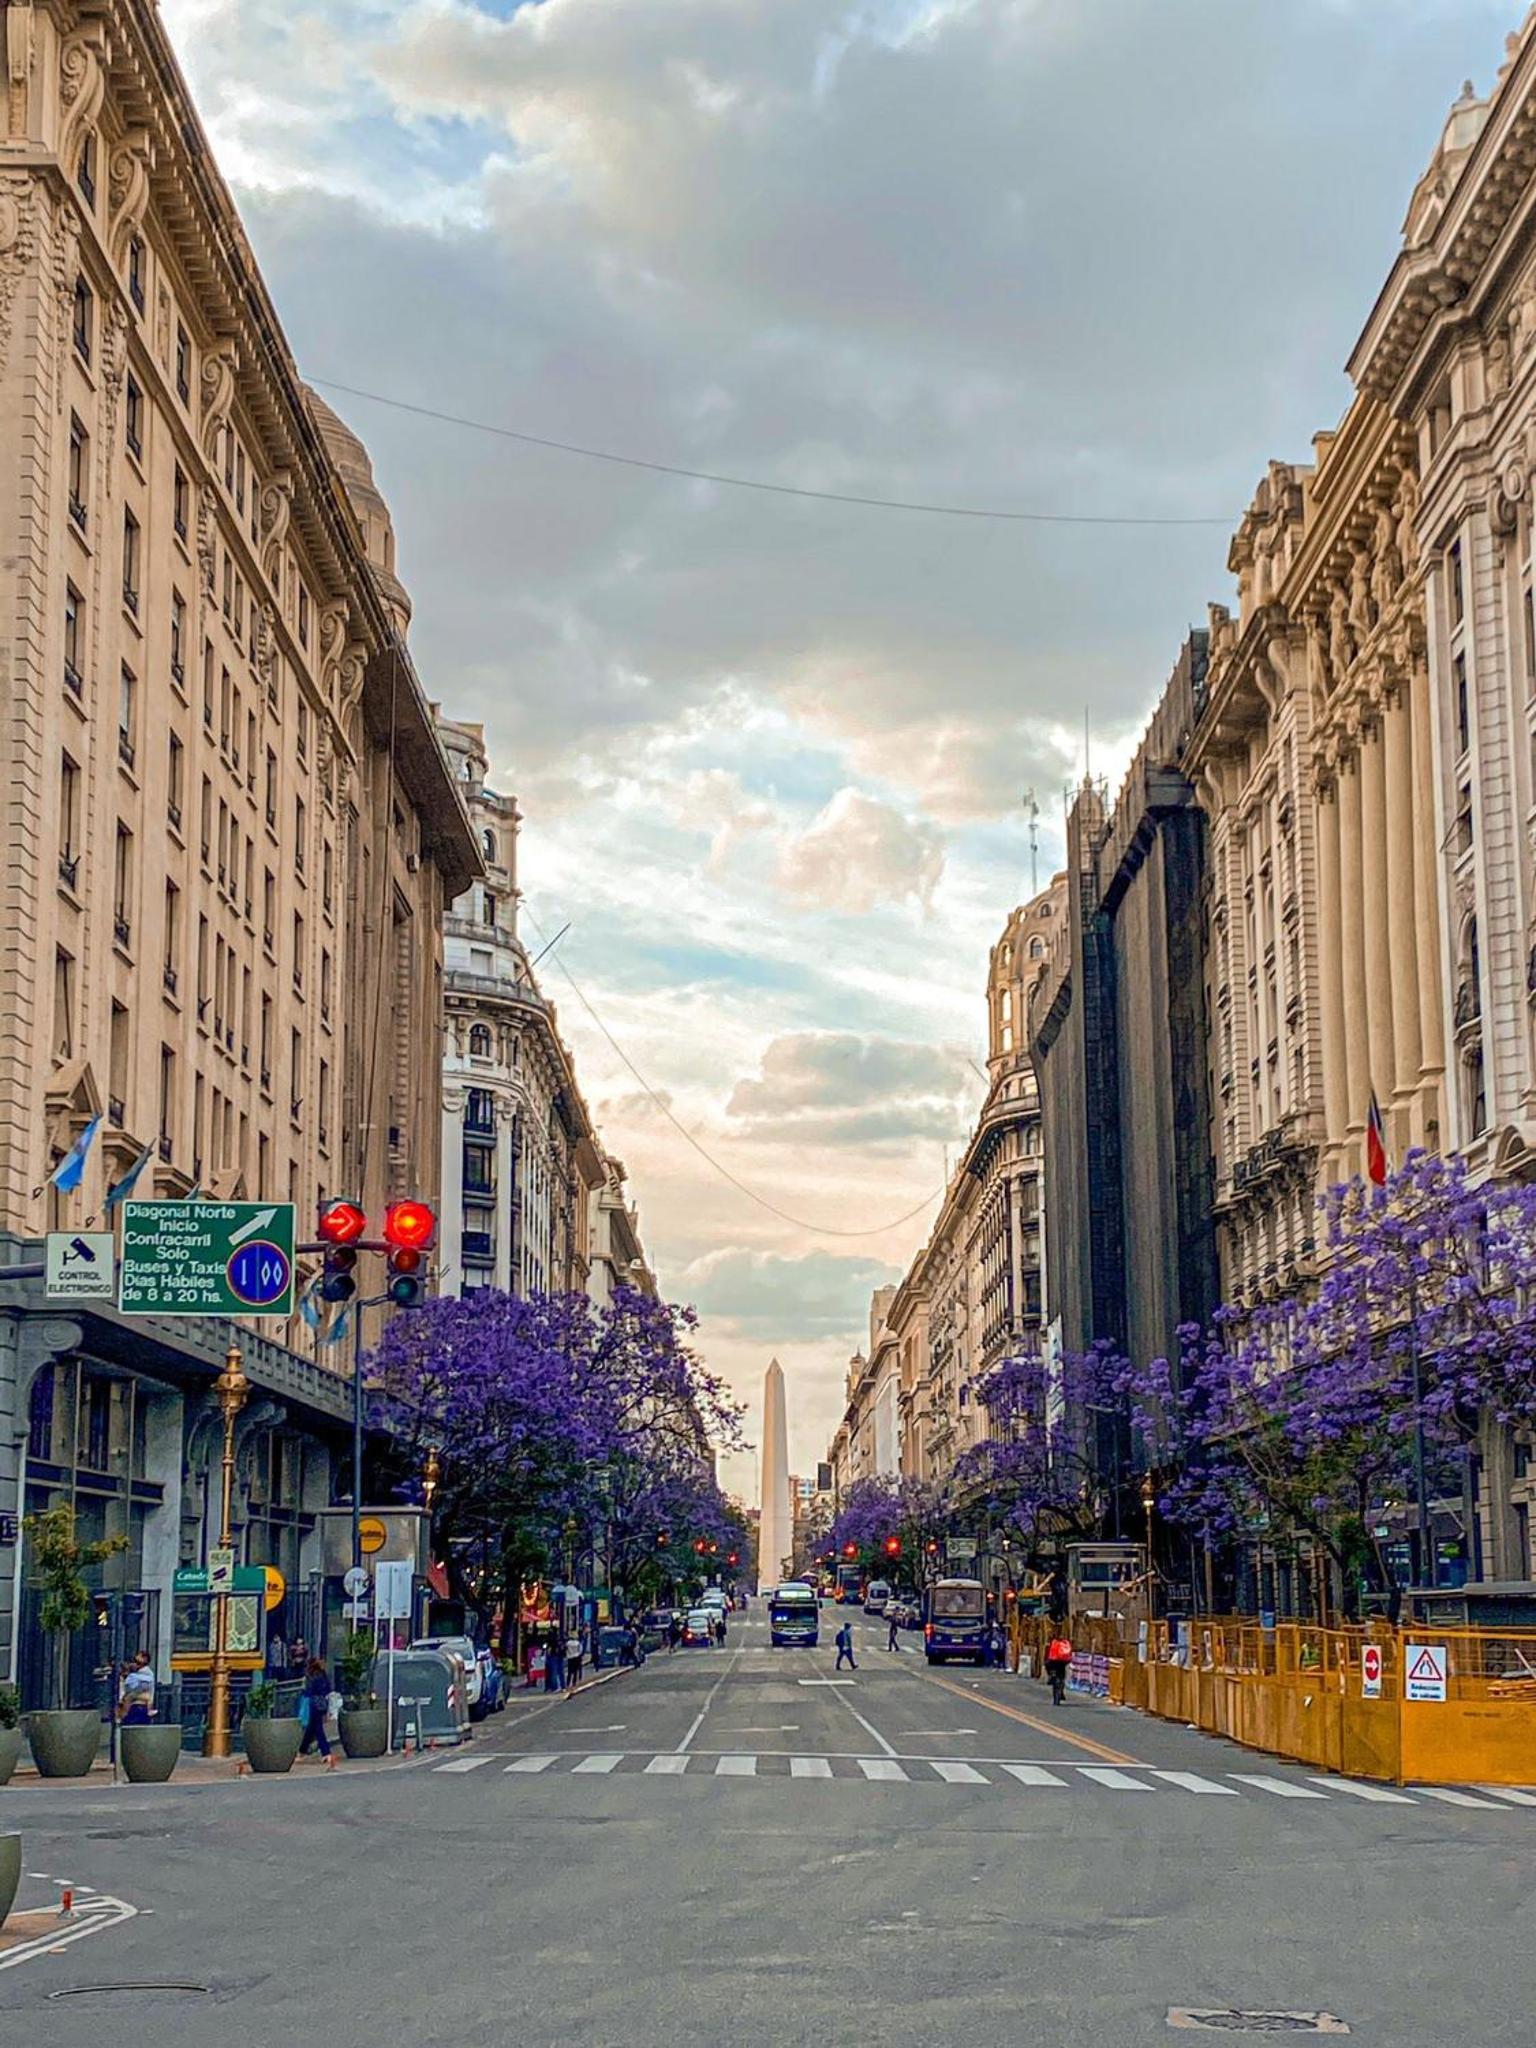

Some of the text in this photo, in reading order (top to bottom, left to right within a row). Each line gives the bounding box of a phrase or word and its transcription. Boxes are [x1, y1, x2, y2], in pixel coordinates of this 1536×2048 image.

[126, 1204, 236, 1220] Diagonal Norte
[159, 1220, 199, 1232] Inicio
[156, 1246, 190, 1260] Solo
[124, 1259, 227, 1276] Buses y Taxis
[58, 1271, 102, 1280] CONTROL
[48, 1284, 112, 1293] ELECTRONICO
[122, 1287, 142, 1301] de
[147, 1287, 159, 1302] 8
[162, 1291, 173, 1302] a
[176, 1288, 198, 1302] 20
